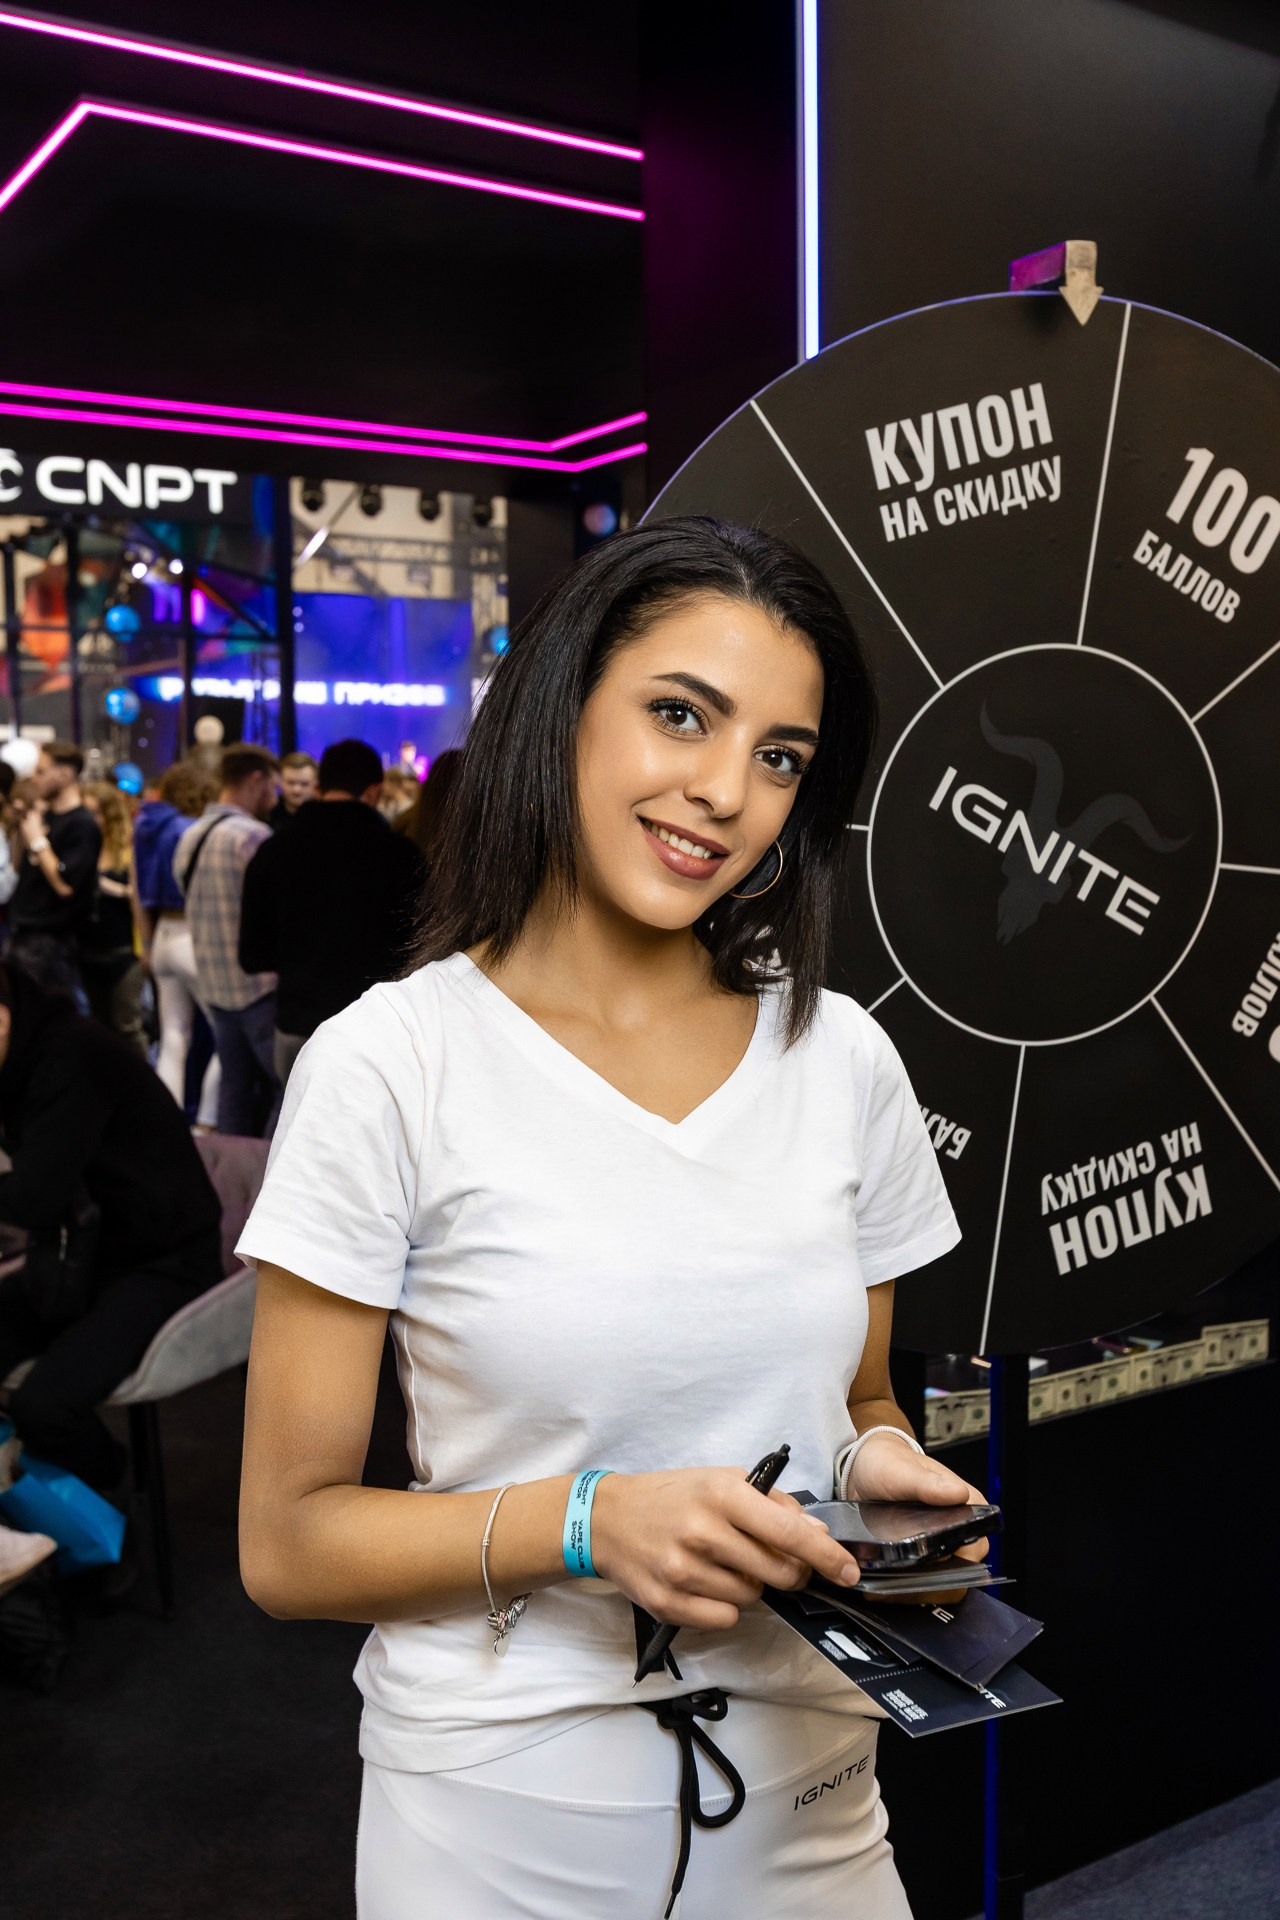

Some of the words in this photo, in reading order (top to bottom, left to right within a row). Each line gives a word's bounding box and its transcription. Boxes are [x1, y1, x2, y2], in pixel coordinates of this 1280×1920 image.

[864, 382, 1054, 492] КУПОН
[35, 455, 238, 515] CNPT
[879, 496, 929, 543] НА
[933, 455, 1061, 527] СКИДКУ
[1165, 447, 1280, 574] 100
[1132, 529, 1241, 623] БАЛЛОВ
[928, 766, 1160, 936] IGNITE
[1041, 1141, 1156, 1216] СКИДКУ
[1160, 1122, 1202, 1164] НА
[1049, 1164, 1213, 1276] КУПОН
[794, 1754, 870, 1811] IGNITE
